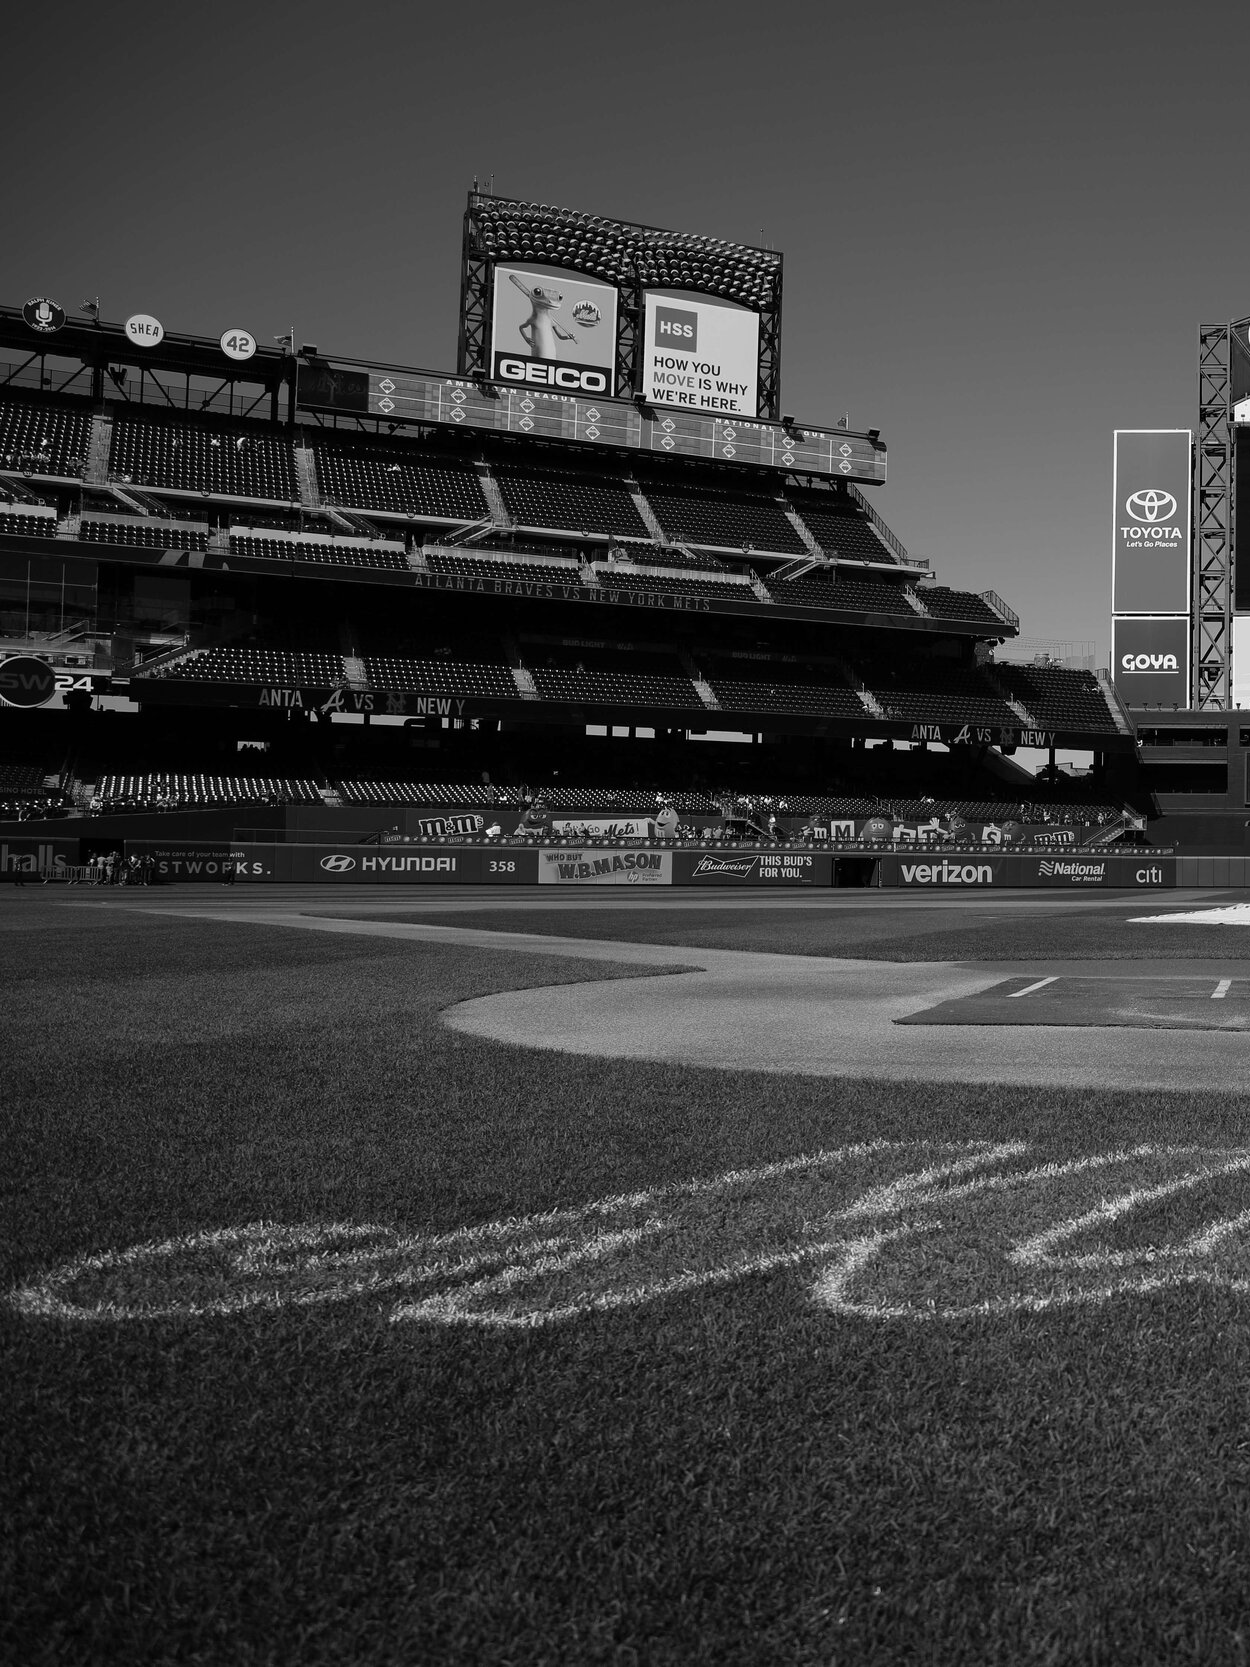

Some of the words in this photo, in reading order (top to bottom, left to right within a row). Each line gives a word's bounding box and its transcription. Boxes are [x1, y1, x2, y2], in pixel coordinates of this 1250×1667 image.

[130, 323, 159, 337] SHEA
[660, 321, 694, 338] HSS
[226, 336, 250, 352] 42
[654, 356, 689, 371] HOW
[691, 361, 721, 376] YOU
[499, 359, 607, 393] GEICO
[653, 372, 695, 388] MOVE
[698, 378, 712, 390] IS
[715, 381, 748, 396] WHY
[526, 392, 577, 402] LEAGUE
[652, 387, 697, 405] WE'RE
[701, 396, 741, 412] HERE.
[715, 418, 774, 431] NATIONAL
[1120, 527, 1182, 539] TOYOTA
[1144, 541, 1154, 549] Go
[1155, 541, 1178, 549] Places
[414, 573, 485, 592] ATLANTA
[494, 580, 553, 598] BRAVES
[562, 586, 580, 600] VS
[589, 588, 620, 604] NEW
[628, 592, 665, 608] YORK
[673, 596, 711, 612] METS
[1121, 653, 1180, 671] GOYA
[54, 674, 94, 692] 24
[353, 693, 375, 710] VS
[416, 696, 451, 715] NEW
[20, 787, 48, 796] HOTEL
[361, 857, 457, 872] HYUNDAI
[545, 853, 565, 861] WHO
[567, 853, 583, 861] BUT
[760, 855, 781, 866] THIS
[783, 855, 813, 866] BUD'S
[488, 860, 516, 872] 358
[698, 860, 753, 871] Budweiser
[759, 867, 778, 878] FOR
[781, 867, 803, 878] YOU.
[901, 860, 993, 883] verizon
[1135, 866, 1163, 884] citi
